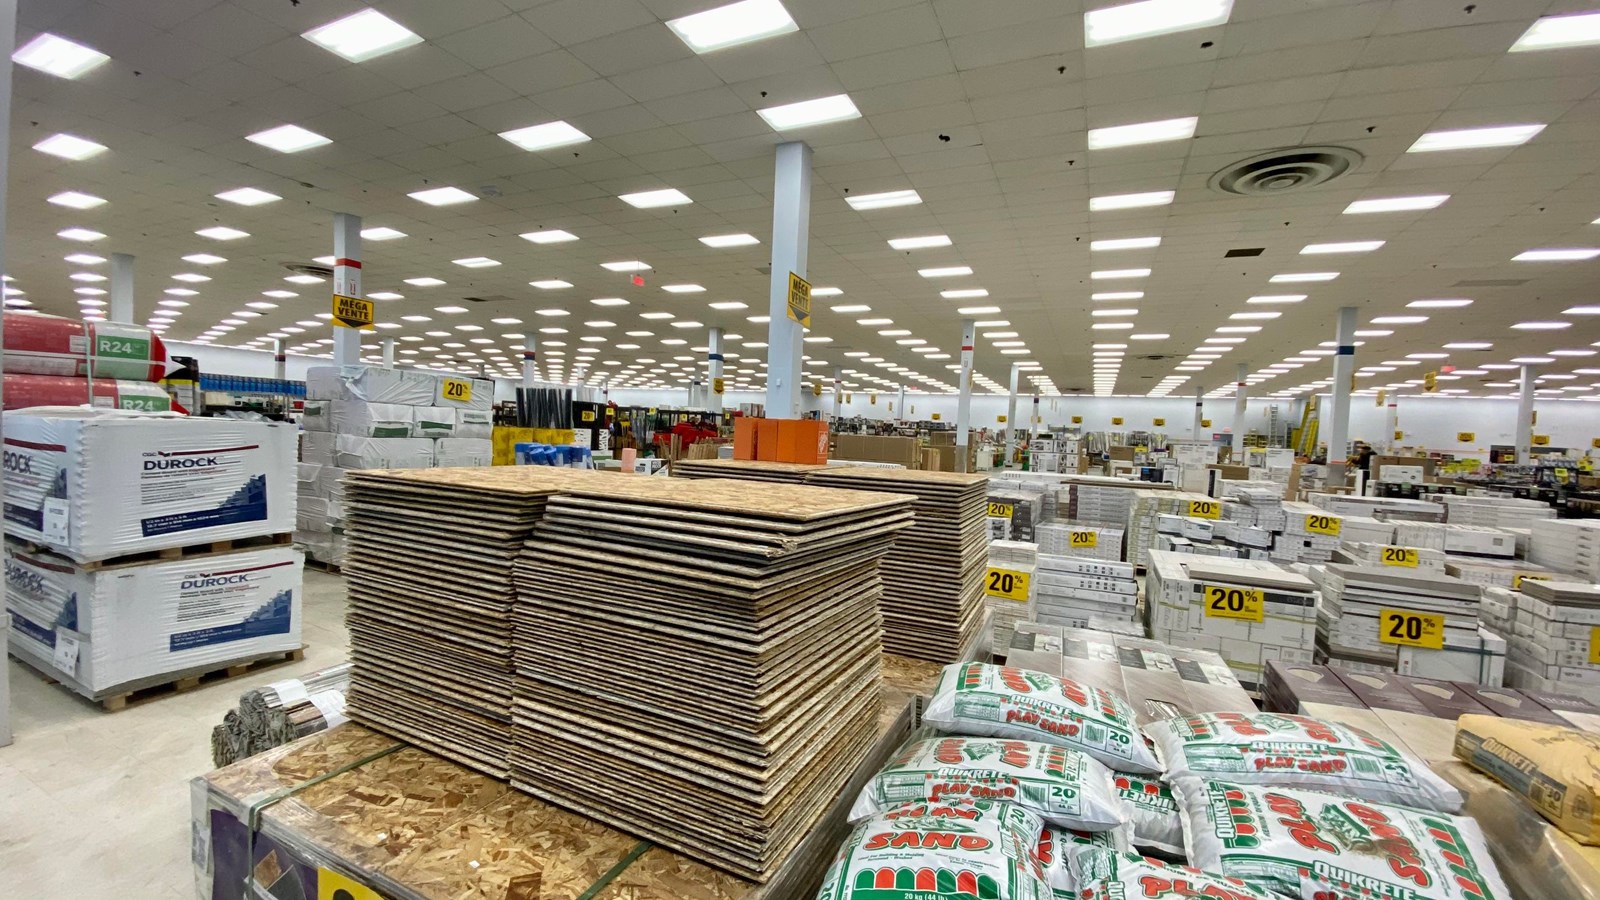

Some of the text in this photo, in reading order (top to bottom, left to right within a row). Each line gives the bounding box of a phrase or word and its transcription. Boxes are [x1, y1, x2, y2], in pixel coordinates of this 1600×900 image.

[338, 306, 369, 320] VENTE
[100, 340, 132, 354] R24
[143, 456, 218, 471] DUROCK
[181, 574, 249, 589] DUROCK
[1006, 709, 1040, 726] PLAY
[1039, 718, 1080, 737] SAND
[1109, 730, 1130, 745] 20
[937, 766, 1010, 780] QUIKRETE
[1254, 757, 1348, 773] PLAY SAND
[932, 783, 970, 799] PLAY
[969, 785, 1017, 798] SAND
[1052, 786, 1076, 799] 20
[1009, 808, 1026, 824] 20
[1263, 792, 1341, 856] PLAY
[863, 831, 993, 851] SAND
[1343, 801, 1433, 888] SAND
[1313, 860, 1417, 900] QUIKRETE
